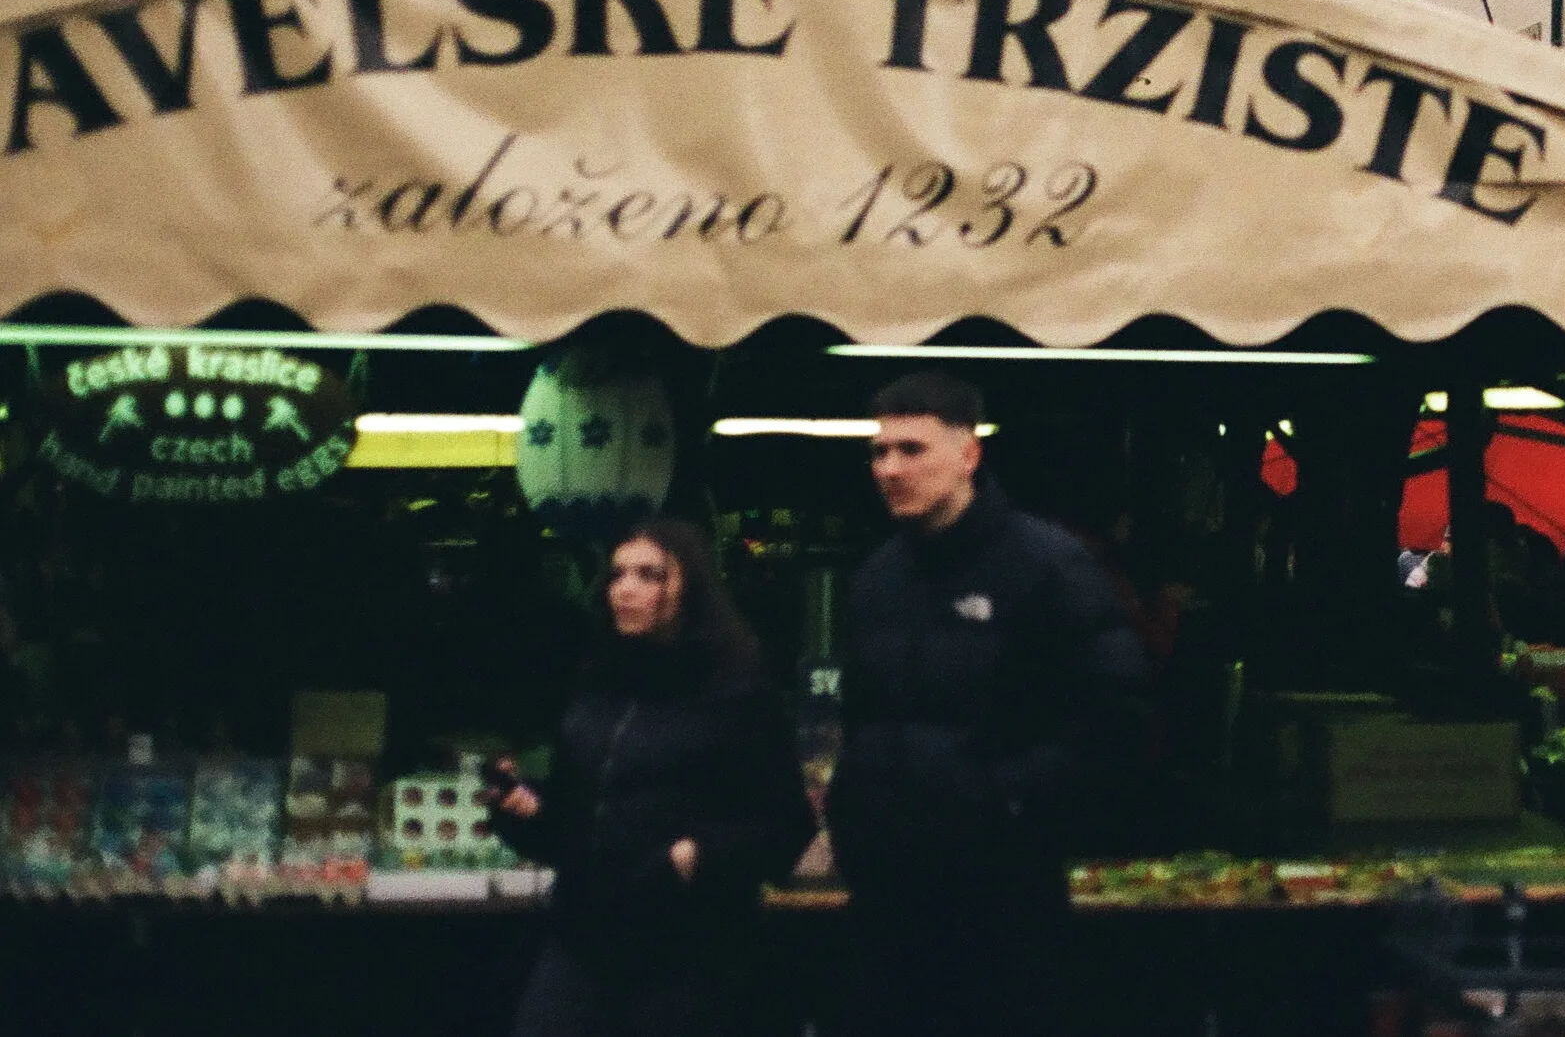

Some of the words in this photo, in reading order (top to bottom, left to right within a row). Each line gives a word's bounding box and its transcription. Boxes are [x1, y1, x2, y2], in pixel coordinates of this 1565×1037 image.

[312, 132, 794, 245] založeno
[836, 160, 1099, 249] 1232
[130, 466, 266, 502] painted
[276, 433, 352, 492] eggs
[150, 433, 255, 463] czech
